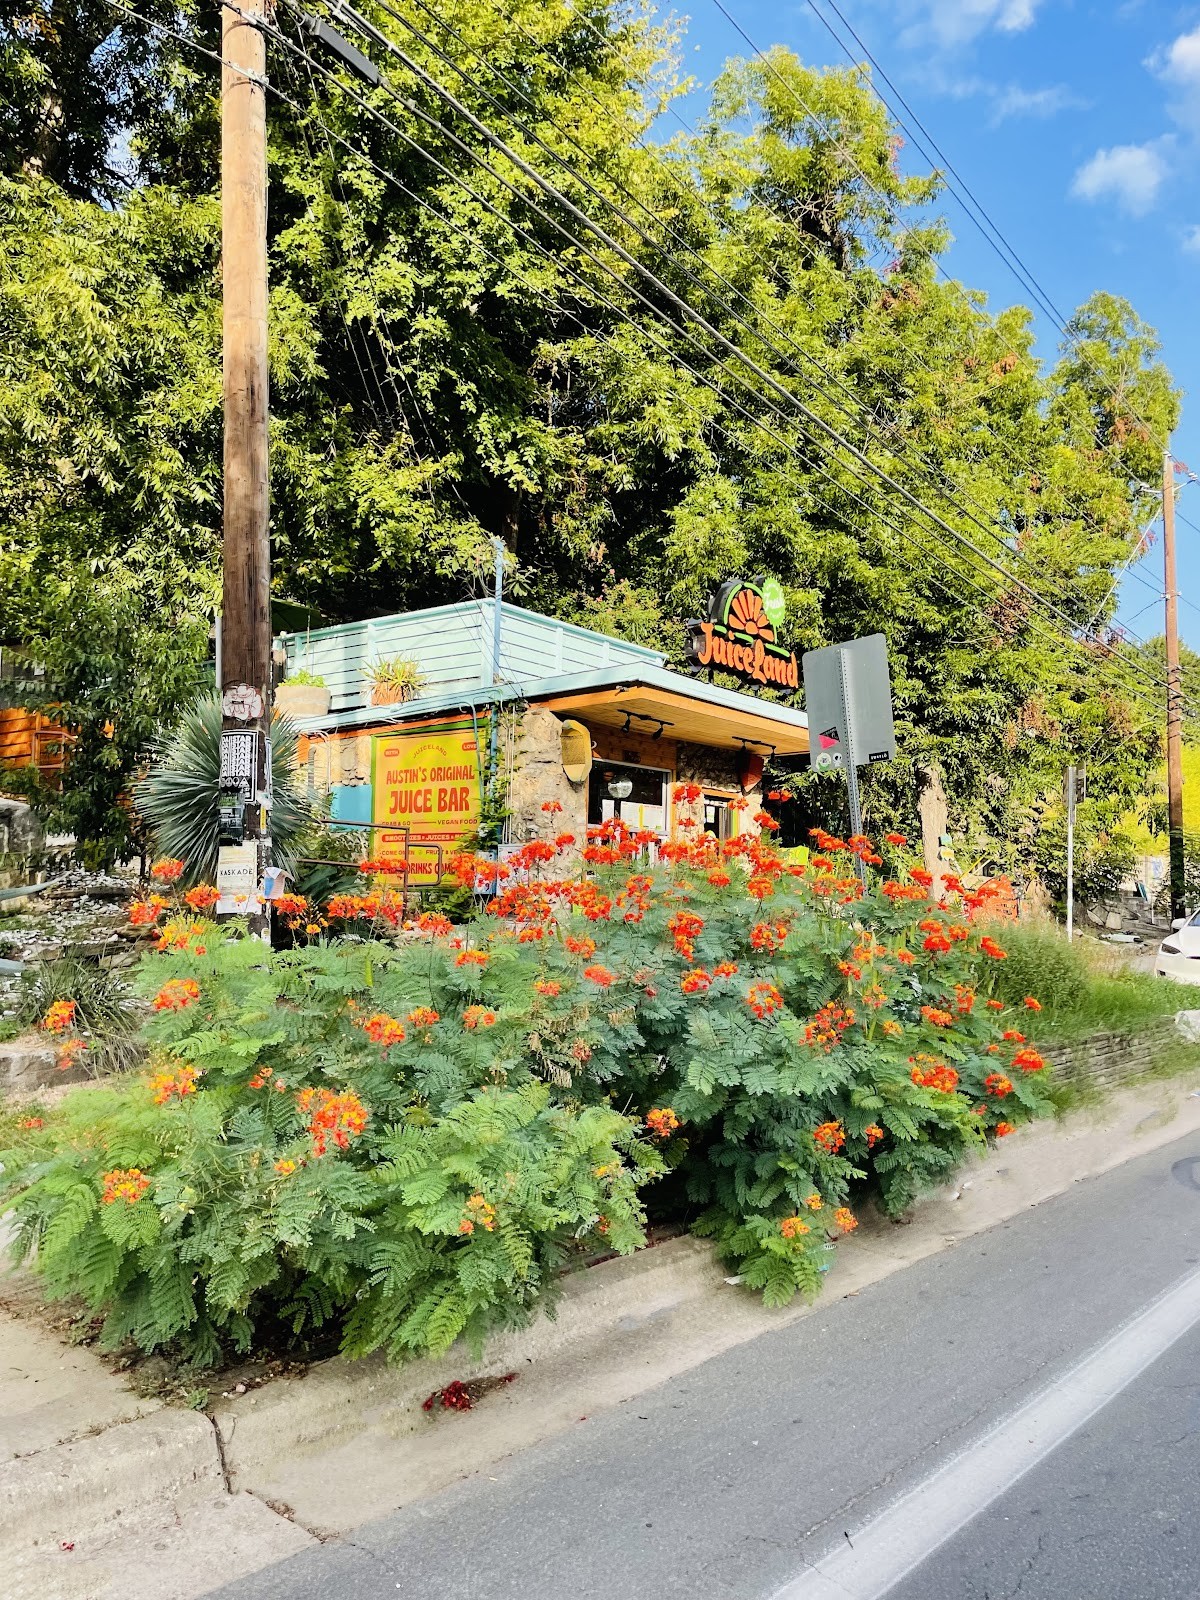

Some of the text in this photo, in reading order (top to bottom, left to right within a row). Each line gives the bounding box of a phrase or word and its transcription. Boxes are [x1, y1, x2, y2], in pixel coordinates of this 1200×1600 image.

[698, 621, 798, 688] JuiceLand
[413, 744, 447, 759] JUICELAND
[386, 765, 475, 785] AUSTIN'S ORIGINAL
[389, 787, 470, 814] JUICE BAR
[220, 868, 253, 876] KASKADE
